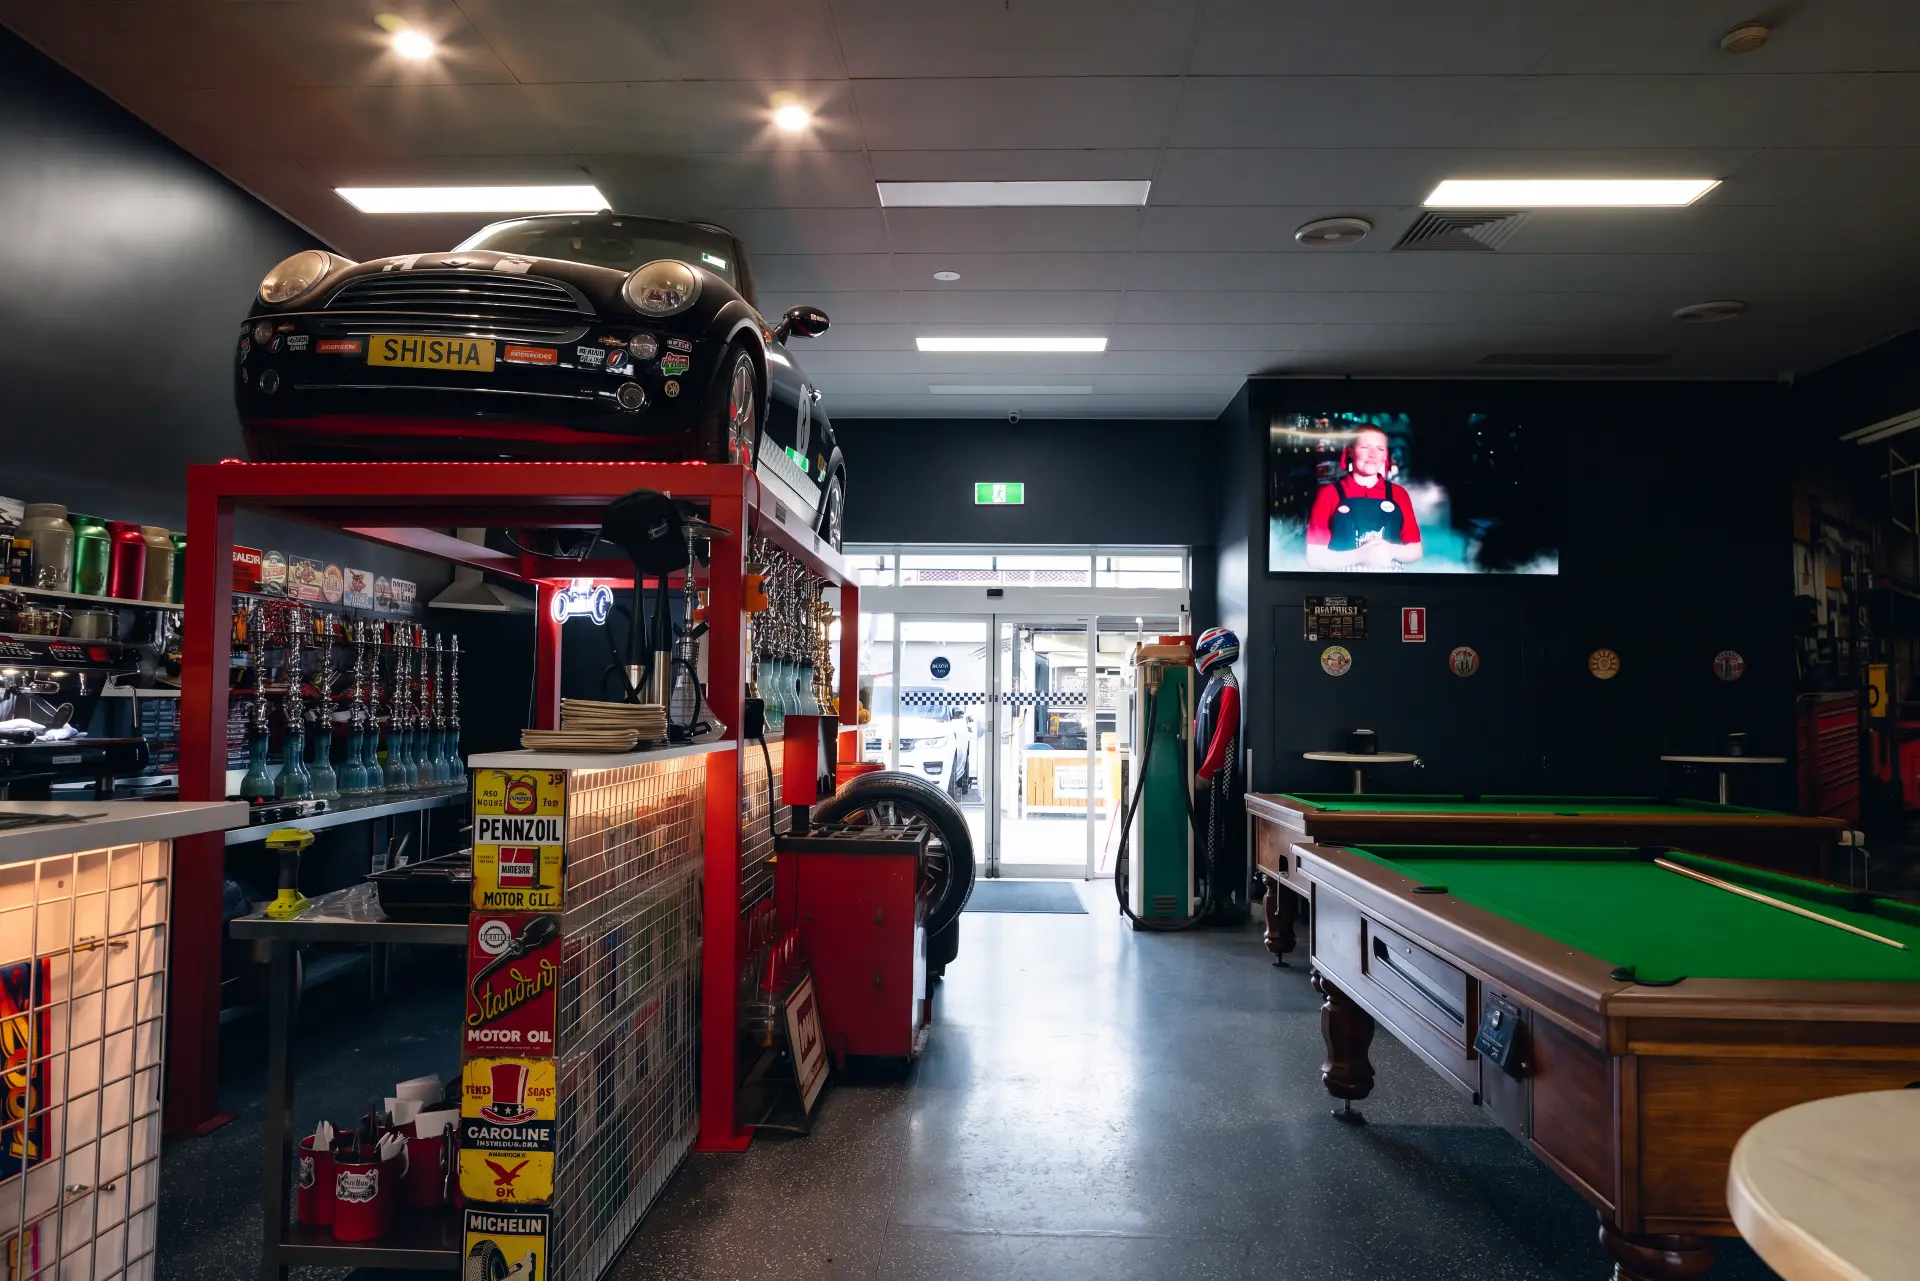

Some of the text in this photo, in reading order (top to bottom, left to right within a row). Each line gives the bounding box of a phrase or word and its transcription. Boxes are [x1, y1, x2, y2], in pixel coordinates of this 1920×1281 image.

[383, 338, 481, 366] SHISHA
[478, 818, 560, 841] PENNZOIL
[484, 892, 524, 906] MOTOR
[468, 1030, 552, 1043] MOTOR OIL
[470, 1215, 542, 1233] MICHELIN
